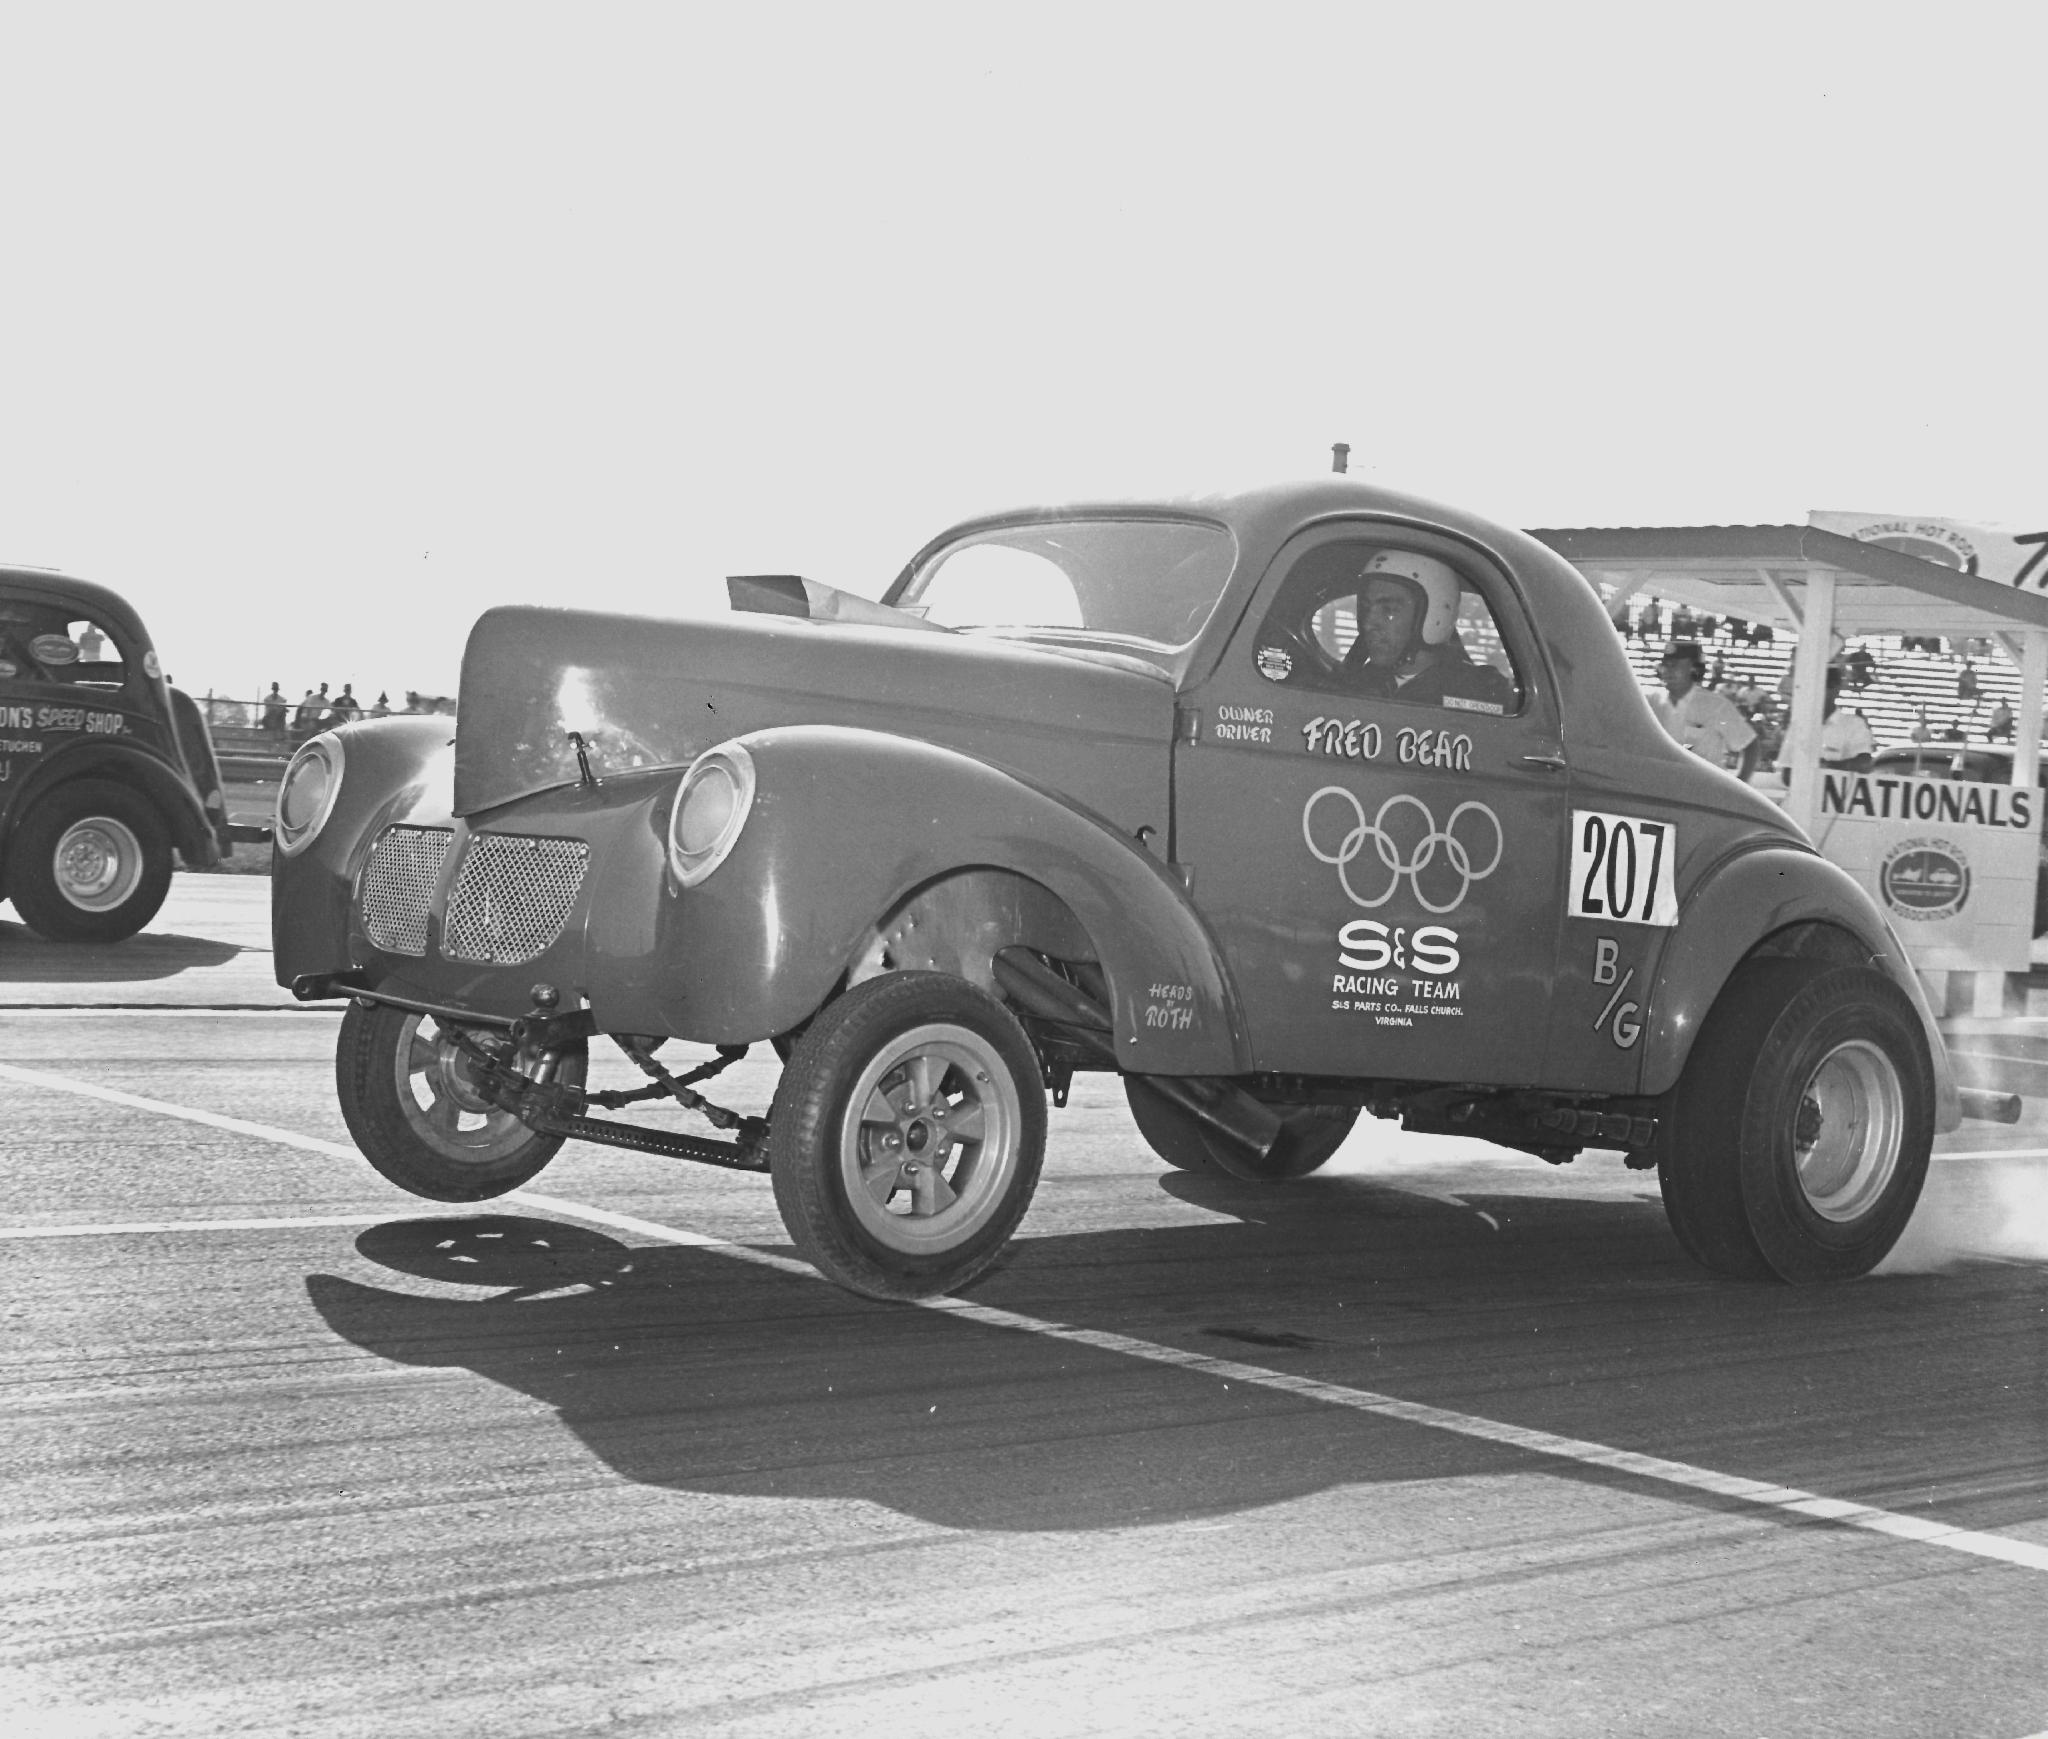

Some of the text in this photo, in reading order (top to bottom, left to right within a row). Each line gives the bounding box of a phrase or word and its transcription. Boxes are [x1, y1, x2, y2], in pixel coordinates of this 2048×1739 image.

[36, 707, 86, 729] SPEED
[85, 711, 124, 735] SHOP
[1218, 705, 1274, 725] OWNER
[1215, 724, 1272, 743] DRIVER
[1303, 716, 1473, 771] FRED BEAR
[1820, 774, 2032, 829] NATIONALS
[1581, 815, 1665, 921] 207
[1338, 919, 1460, 975] S&S
[1148, 983, 1193, 1001] HEADS
[1332, 974, 1460, 1000] RACING TEAM
[1145, 1005, 1193, 1030] ROTH
[1354, 1001, 1382, 1012] PARTS
[1404, 1004, 1429, 1014] FALLS
[1374, 1016, 1414, 1027] VIRGINIA
